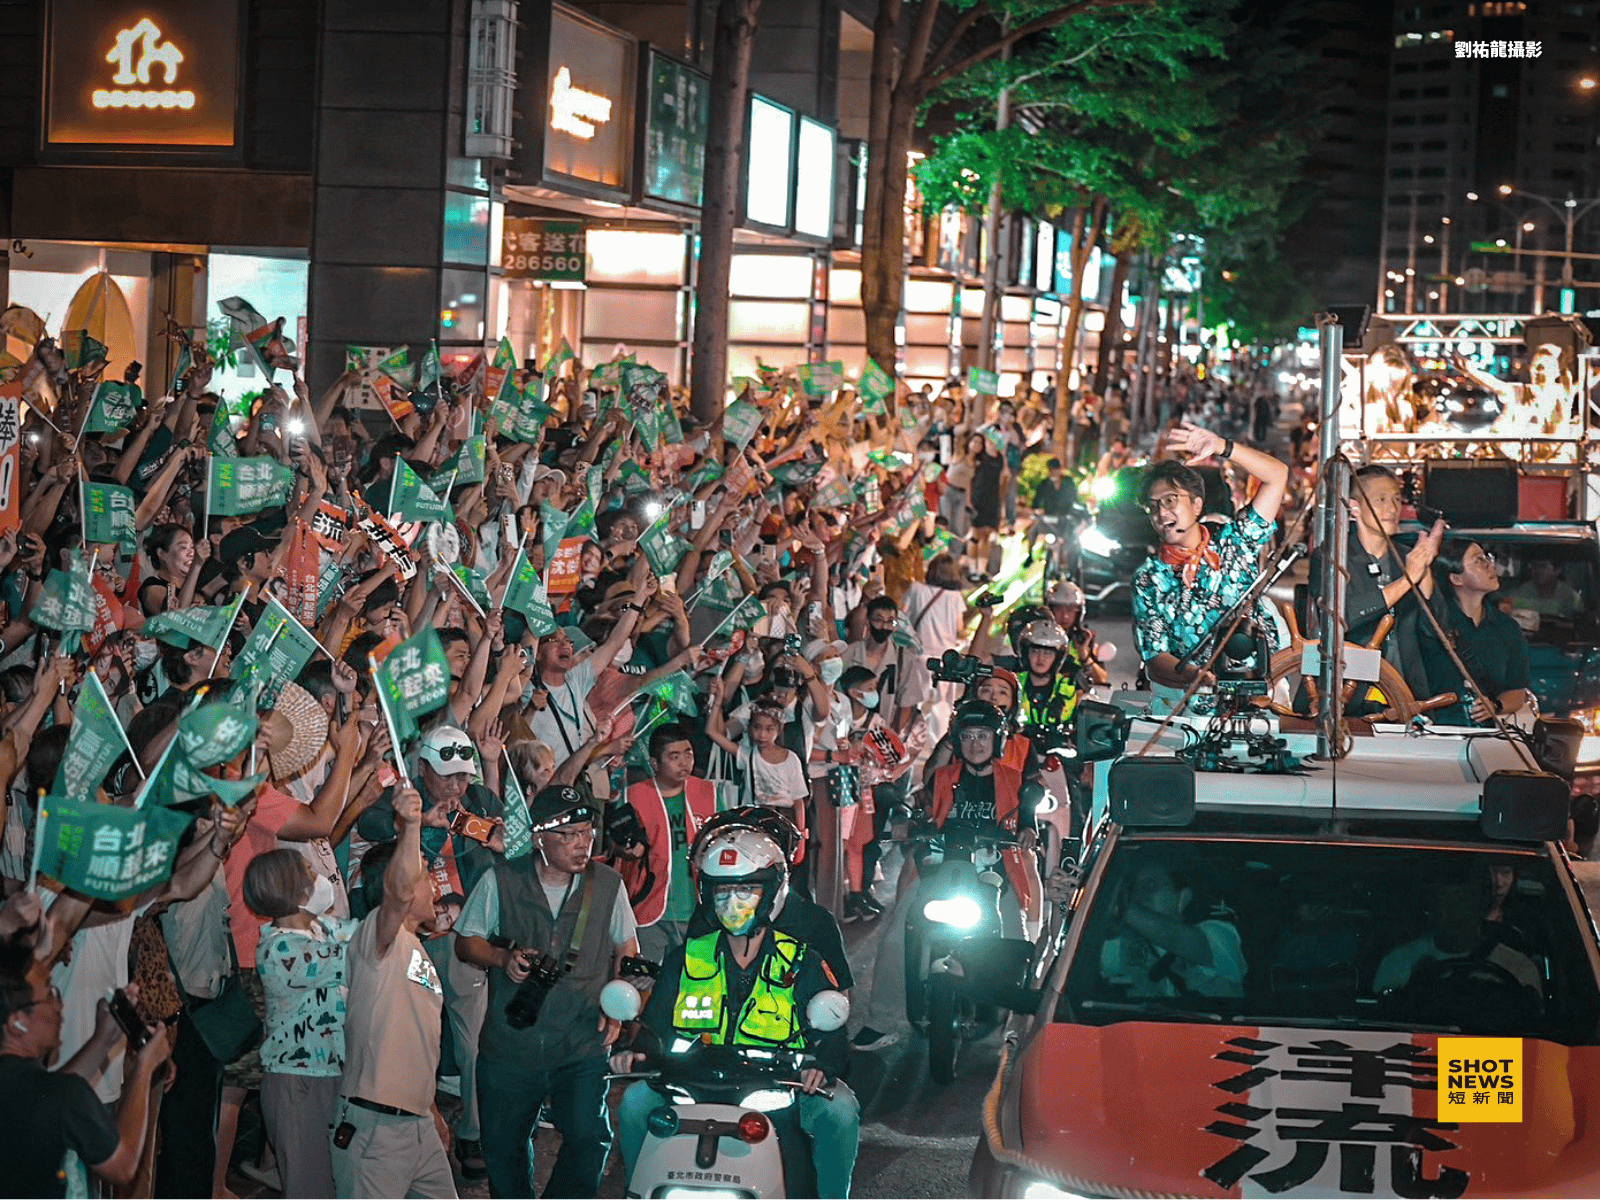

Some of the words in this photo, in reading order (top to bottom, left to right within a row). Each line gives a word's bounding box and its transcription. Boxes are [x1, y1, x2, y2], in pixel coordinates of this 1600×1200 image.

[504, 255, 580, 271] 286560
[667, 1171, 741, 1185] 臺北市政府警察局
